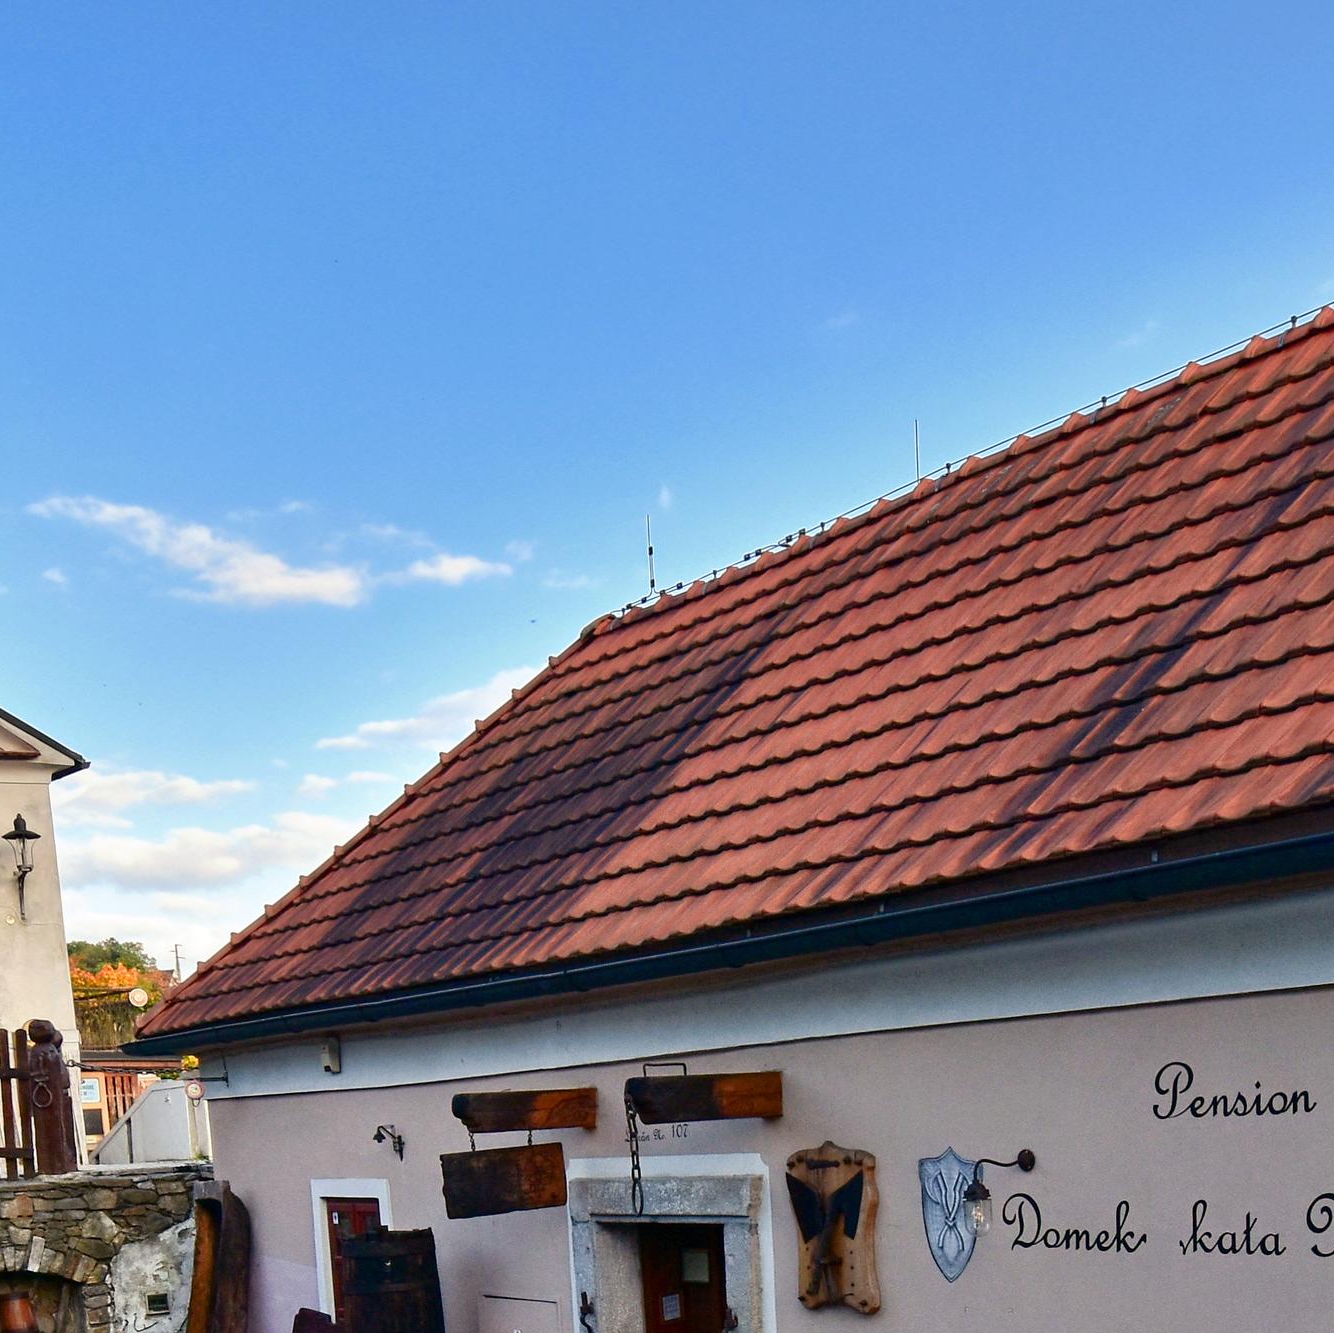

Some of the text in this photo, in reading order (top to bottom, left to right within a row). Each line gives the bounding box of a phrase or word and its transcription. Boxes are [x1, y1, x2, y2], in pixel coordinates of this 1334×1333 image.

[1152, 1061, 1317, 1120] Pension
[671, 1124, 688, 1138] 107
[1001, 1192, 1148, 1253] Domek
[1179, 1199, 1287, 1256] kata
